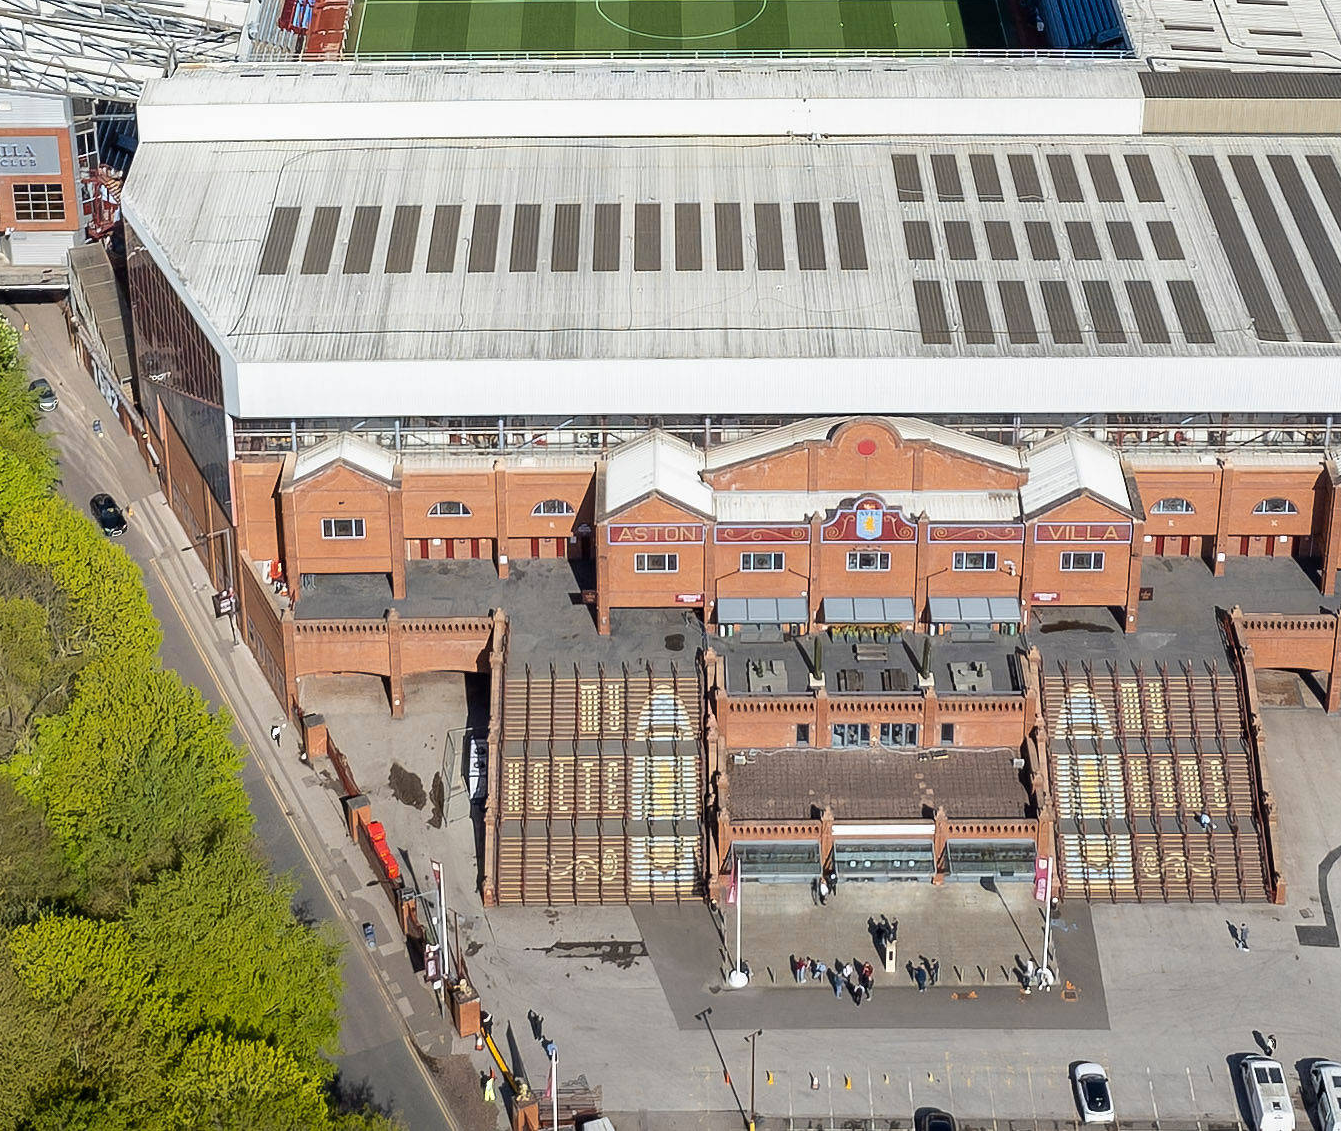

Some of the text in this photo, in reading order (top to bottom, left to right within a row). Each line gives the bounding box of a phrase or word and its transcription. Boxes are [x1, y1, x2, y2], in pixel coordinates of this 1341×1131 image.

[0, 159, 37, 168] CLUB
[617, 524, 1120, 543] ASTON VILLA
[507, 761, 619, 812] HOLTE
